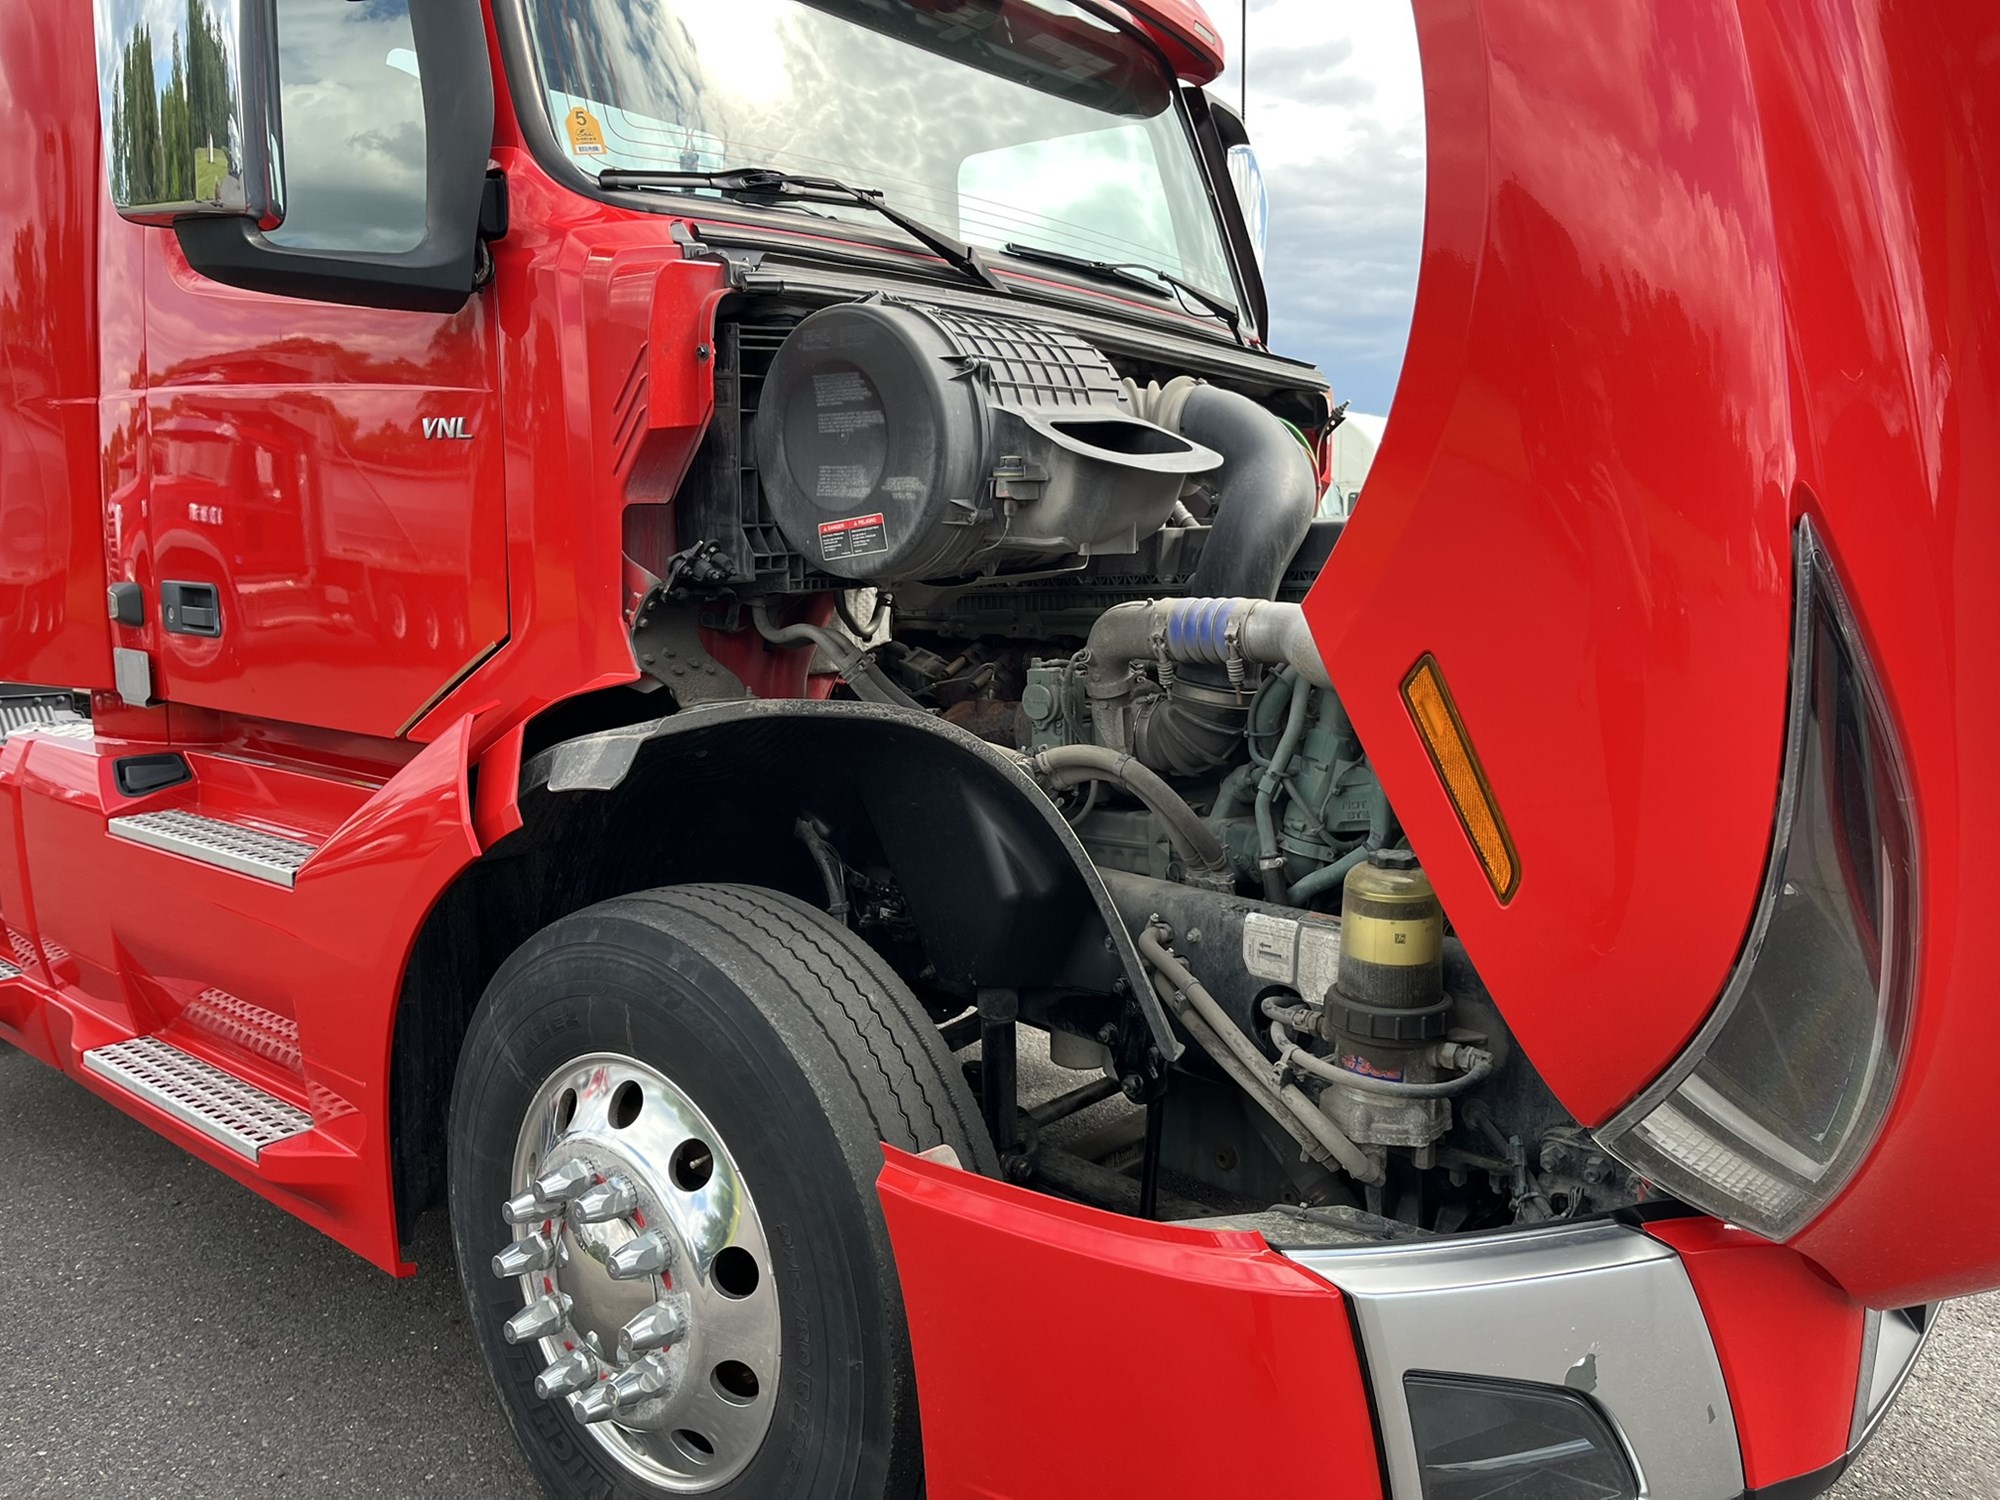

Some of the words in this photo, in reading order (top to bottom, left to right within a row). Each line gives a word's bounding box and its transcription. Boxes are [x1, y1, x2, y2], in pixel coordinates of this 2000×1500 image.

[575, 110, 587, 126] 5
[422, 416, 473, 439] VNL
[857, 516, 877, 526] PELIGRO
[827, 522, 845, 531] DANGER
[1341, 799, 1367, 810] NOT
[1346, 810, 1370, 820] STE
